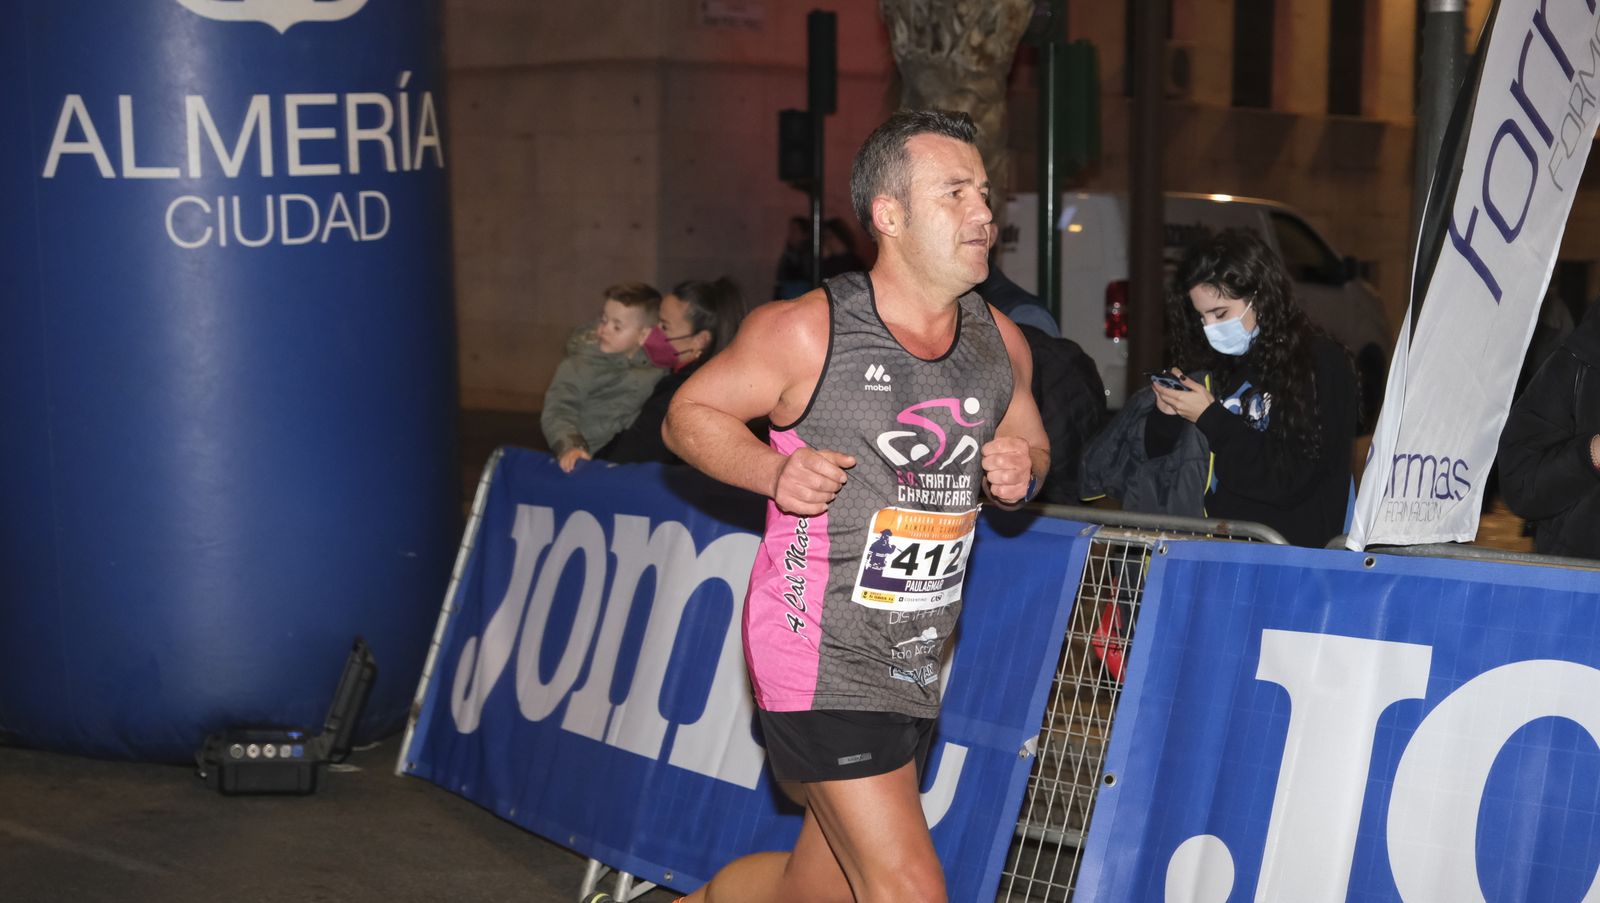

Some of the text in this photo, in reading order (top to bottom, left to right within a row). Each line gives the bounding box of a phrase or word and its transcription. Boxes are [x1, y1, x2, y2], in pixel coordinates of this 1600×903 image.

[42, 70, 445, 179] ALMERÍA
[165, 190, 391, 249] CIUDAD
[864, 384, 892, 392] mobel
[1382, 453, 1472, 502] rmas
[890, 541, 964, 578] 412
